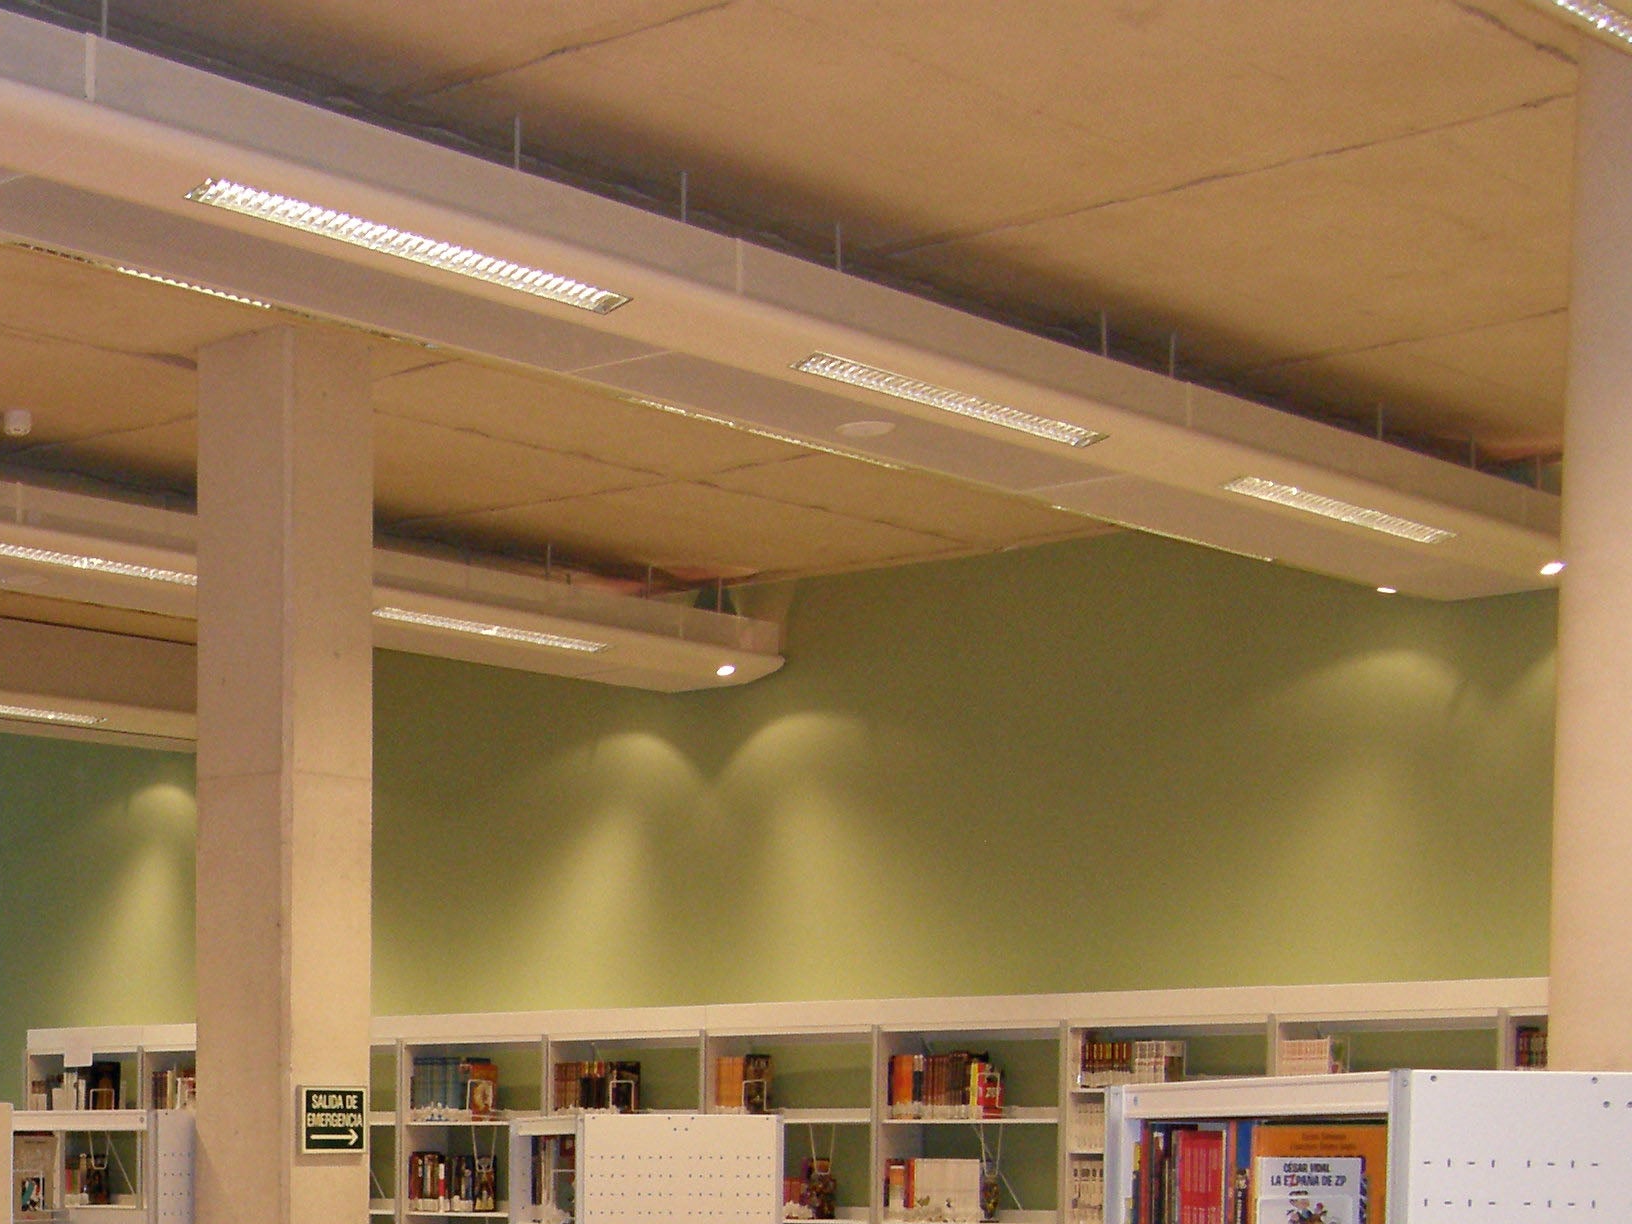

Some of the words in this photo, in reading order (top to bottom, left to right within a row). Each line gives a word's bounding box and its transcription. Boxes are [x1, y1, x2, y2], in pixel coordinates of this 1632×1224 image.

[311, 1094, 344, 1109] SALIDA
[346, 1095, 358, 1109] DE
[307, 1113, 362, 1128] EMERGENCIA
[1271, 1175, 1281, 1186] LA
[1322, 1175, 1332, 1186] DE
[1335, 1175, 1347, 1186] ZP
